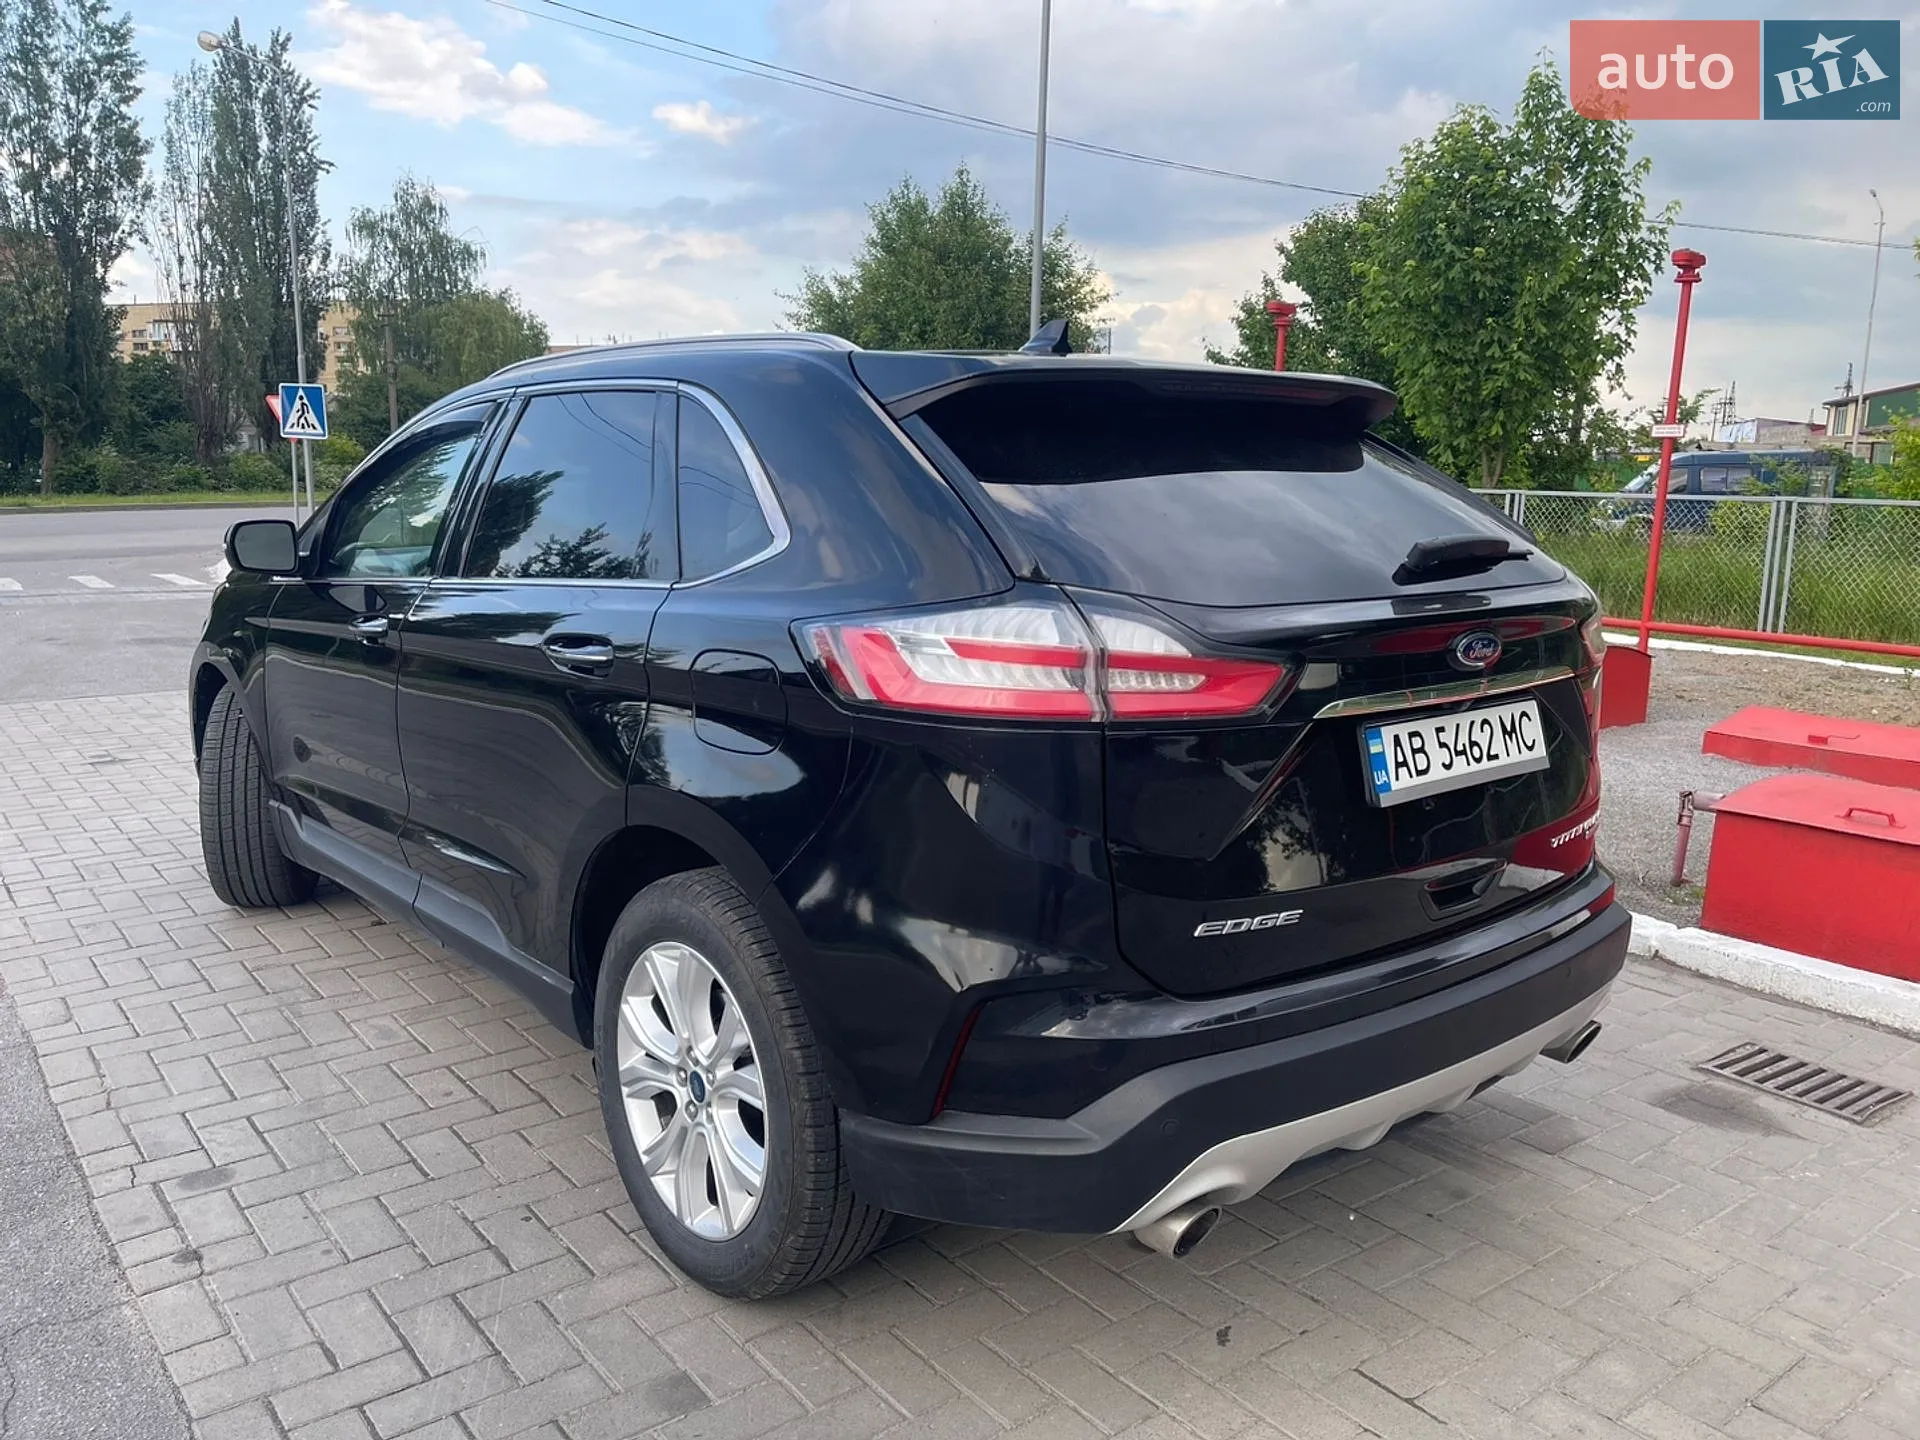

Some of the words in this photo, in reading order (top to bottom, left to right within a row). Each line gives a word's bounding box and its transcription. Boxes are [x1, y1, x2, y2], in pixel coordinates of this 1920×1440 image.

[1393, 730, 1431, 781] AB
[1434, 719, 1499, 771] 5462
[1499, 710, 1536, 757] MC
[1374, 770, 1389, 785] UA
[1194, 909, 1304, 937] EDGE
